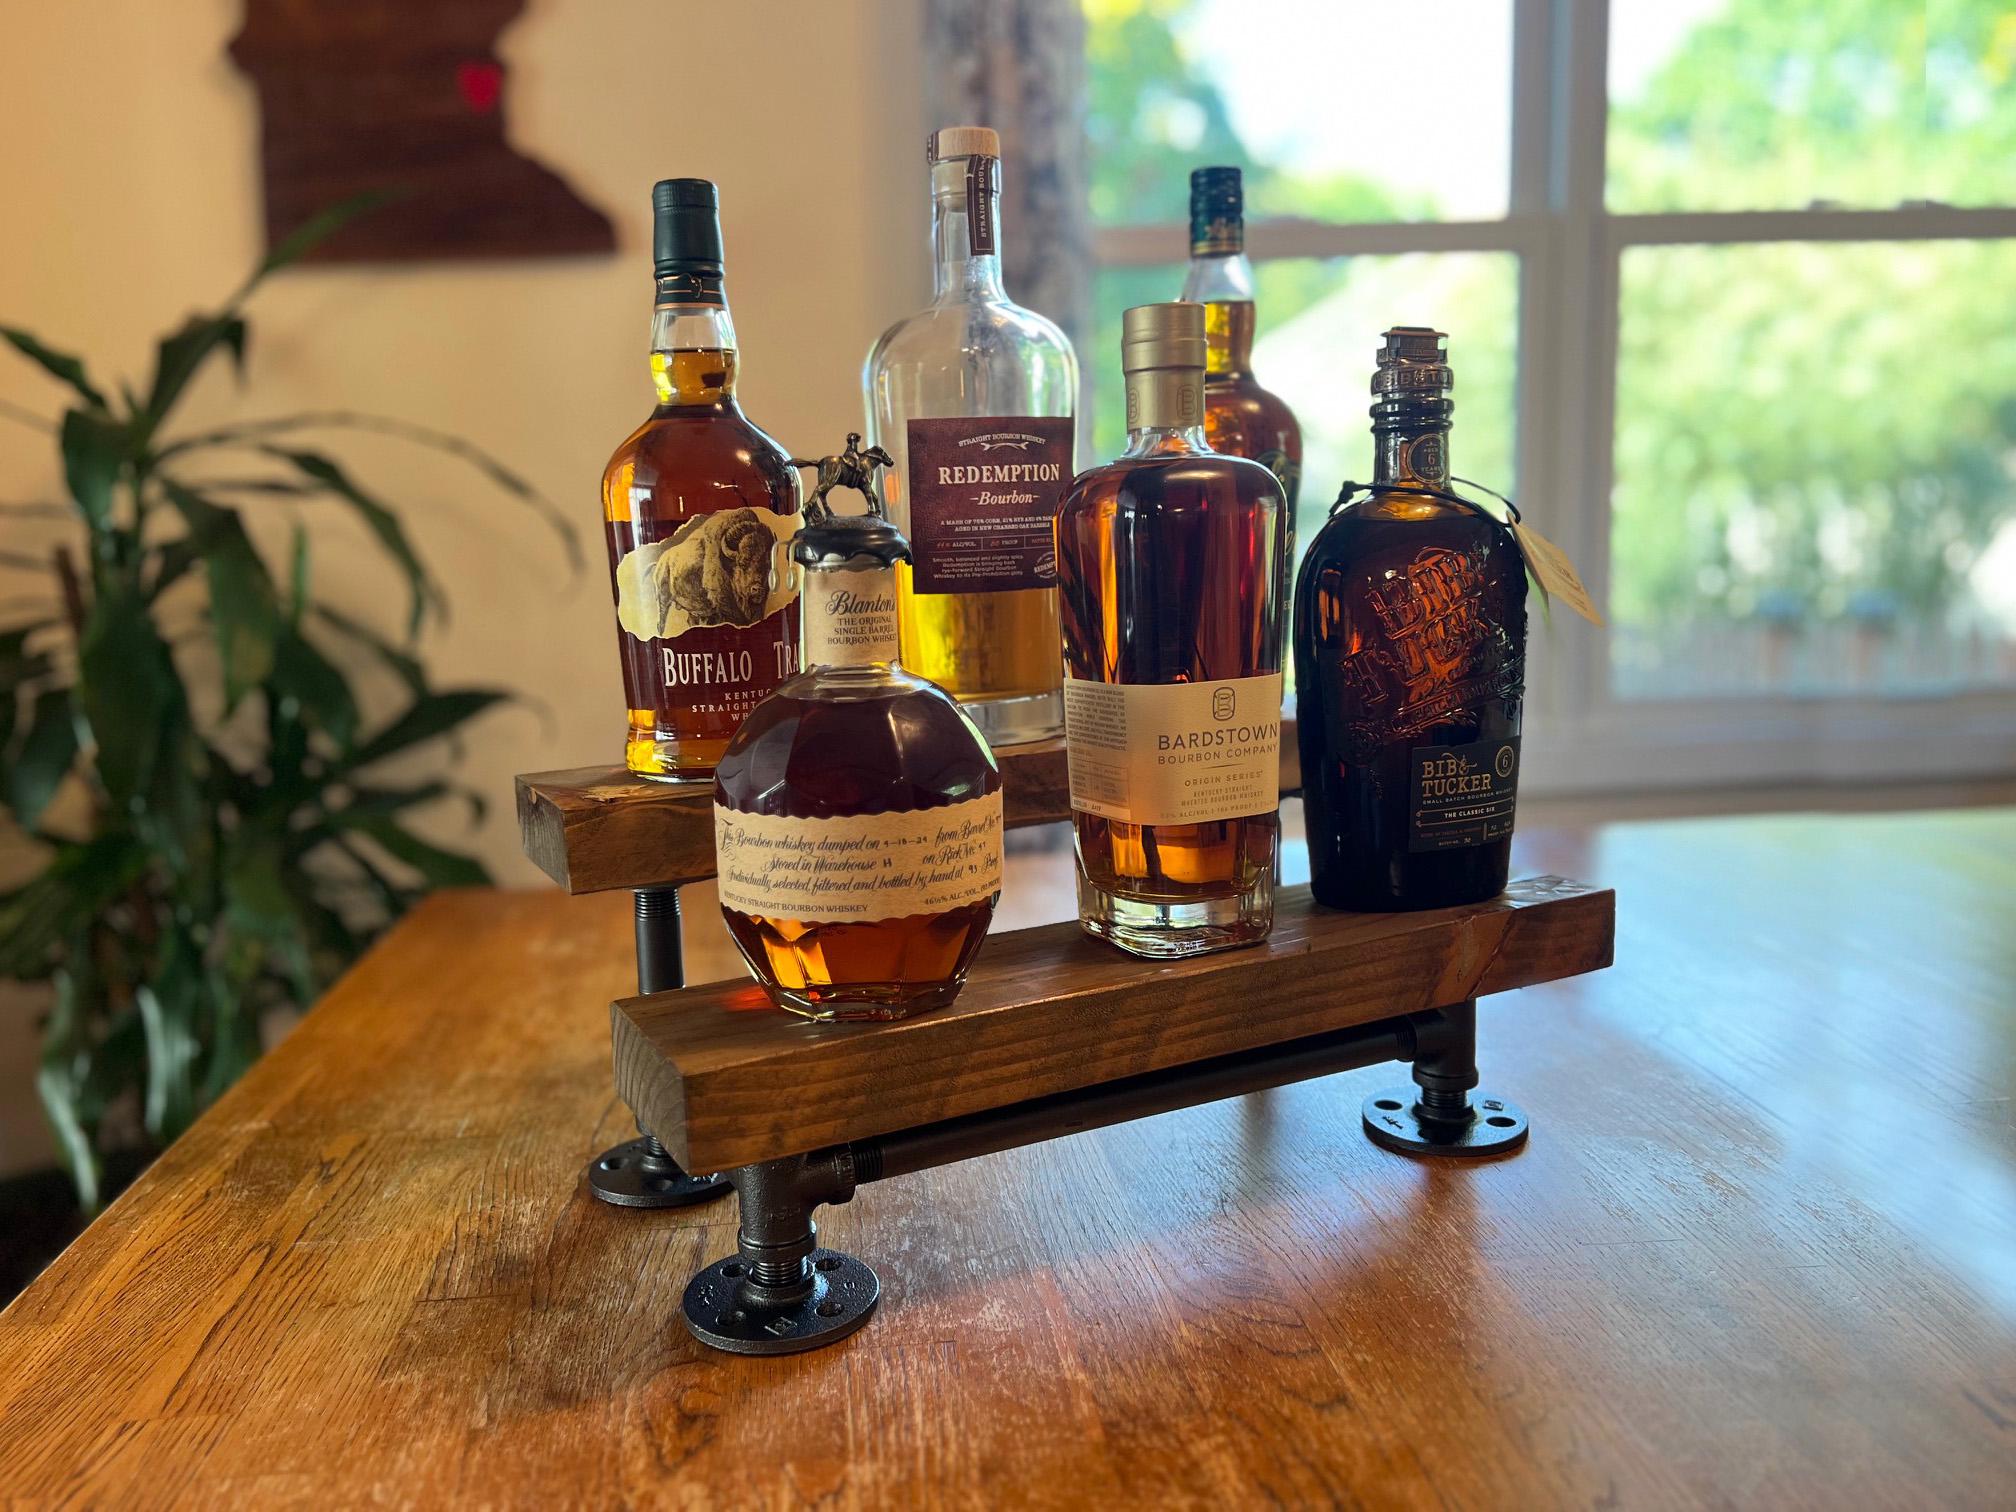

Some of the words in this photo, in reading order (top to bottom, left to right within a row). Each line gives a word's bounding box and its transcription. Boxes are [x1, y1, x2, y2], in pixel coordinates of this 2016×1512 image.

[958, 434, 991, 447] STRAIGHT
[1021, 434, 1046, 445] WHISKEY
[1428, 454, 1435, 464] 6
[938, 464, 1060, 485] REDEMPTION
[838, 618, 858, 626] THE
[834, 627, 866, 635] SINGLE
[827, 636, 870, 645] BOURBON
[662, 647, 752, 687] BUFFALO
[692, 701, 756, 713] STRAIGHT
[1158, 723, 1278, 751] BARDSTOWN
[1158, 752, 1221, 765] BOURBON
[1226, 744, 1278, 758] COMPANY
[1502, 755, 1508, 768] 6
[1185, 776, 1221, 787] ORIGIN
[1422, 774, 1492, 797] TUCKER
[1194, 788, 1223, 797] KENTUCKY
[1225, 784, 1252, 794] STRAIGHT
[1211, 794, 1236, 803] BOURBON
[1240, 791, 1263, 799] WHISKEY
[1467, 792, 1494, 801] BOURBON
[1458, 808, 1484, 816] CLASSIC
[720, 818, 735, 851] This
[735, 828, 774, 848] Bourbon
[774, 835, 815, 856] whiskey
[817, 835, 864, 854] dumped
[866, 840, 880, 850] on
[934, 826, 958, 847] from
[958, 816, 987, 840] Barrel
[763, 856, 802, 873] Stored
[811, 856, 876, 875] Warehouse
[884, 858, 892, 868] H
[922, 855, 935, 864] on
[935, 846, 962, 865] Rick
[727, 866, 771, 892] Individually
[811, 877, 852, 897] filtered
[853, 876, 878, 892] and
[878, 873, 915, 890] bottled
[915, 872, 928, 890] by
[928, 866, 955, 883] hand
[724, 891, 747, 904] KENTUCKY
[748, 898, 781, 910] STRAIGHT
[782, 903, 825, 912] BOURBON
[826, 904, 868, 912] WHISKEY
